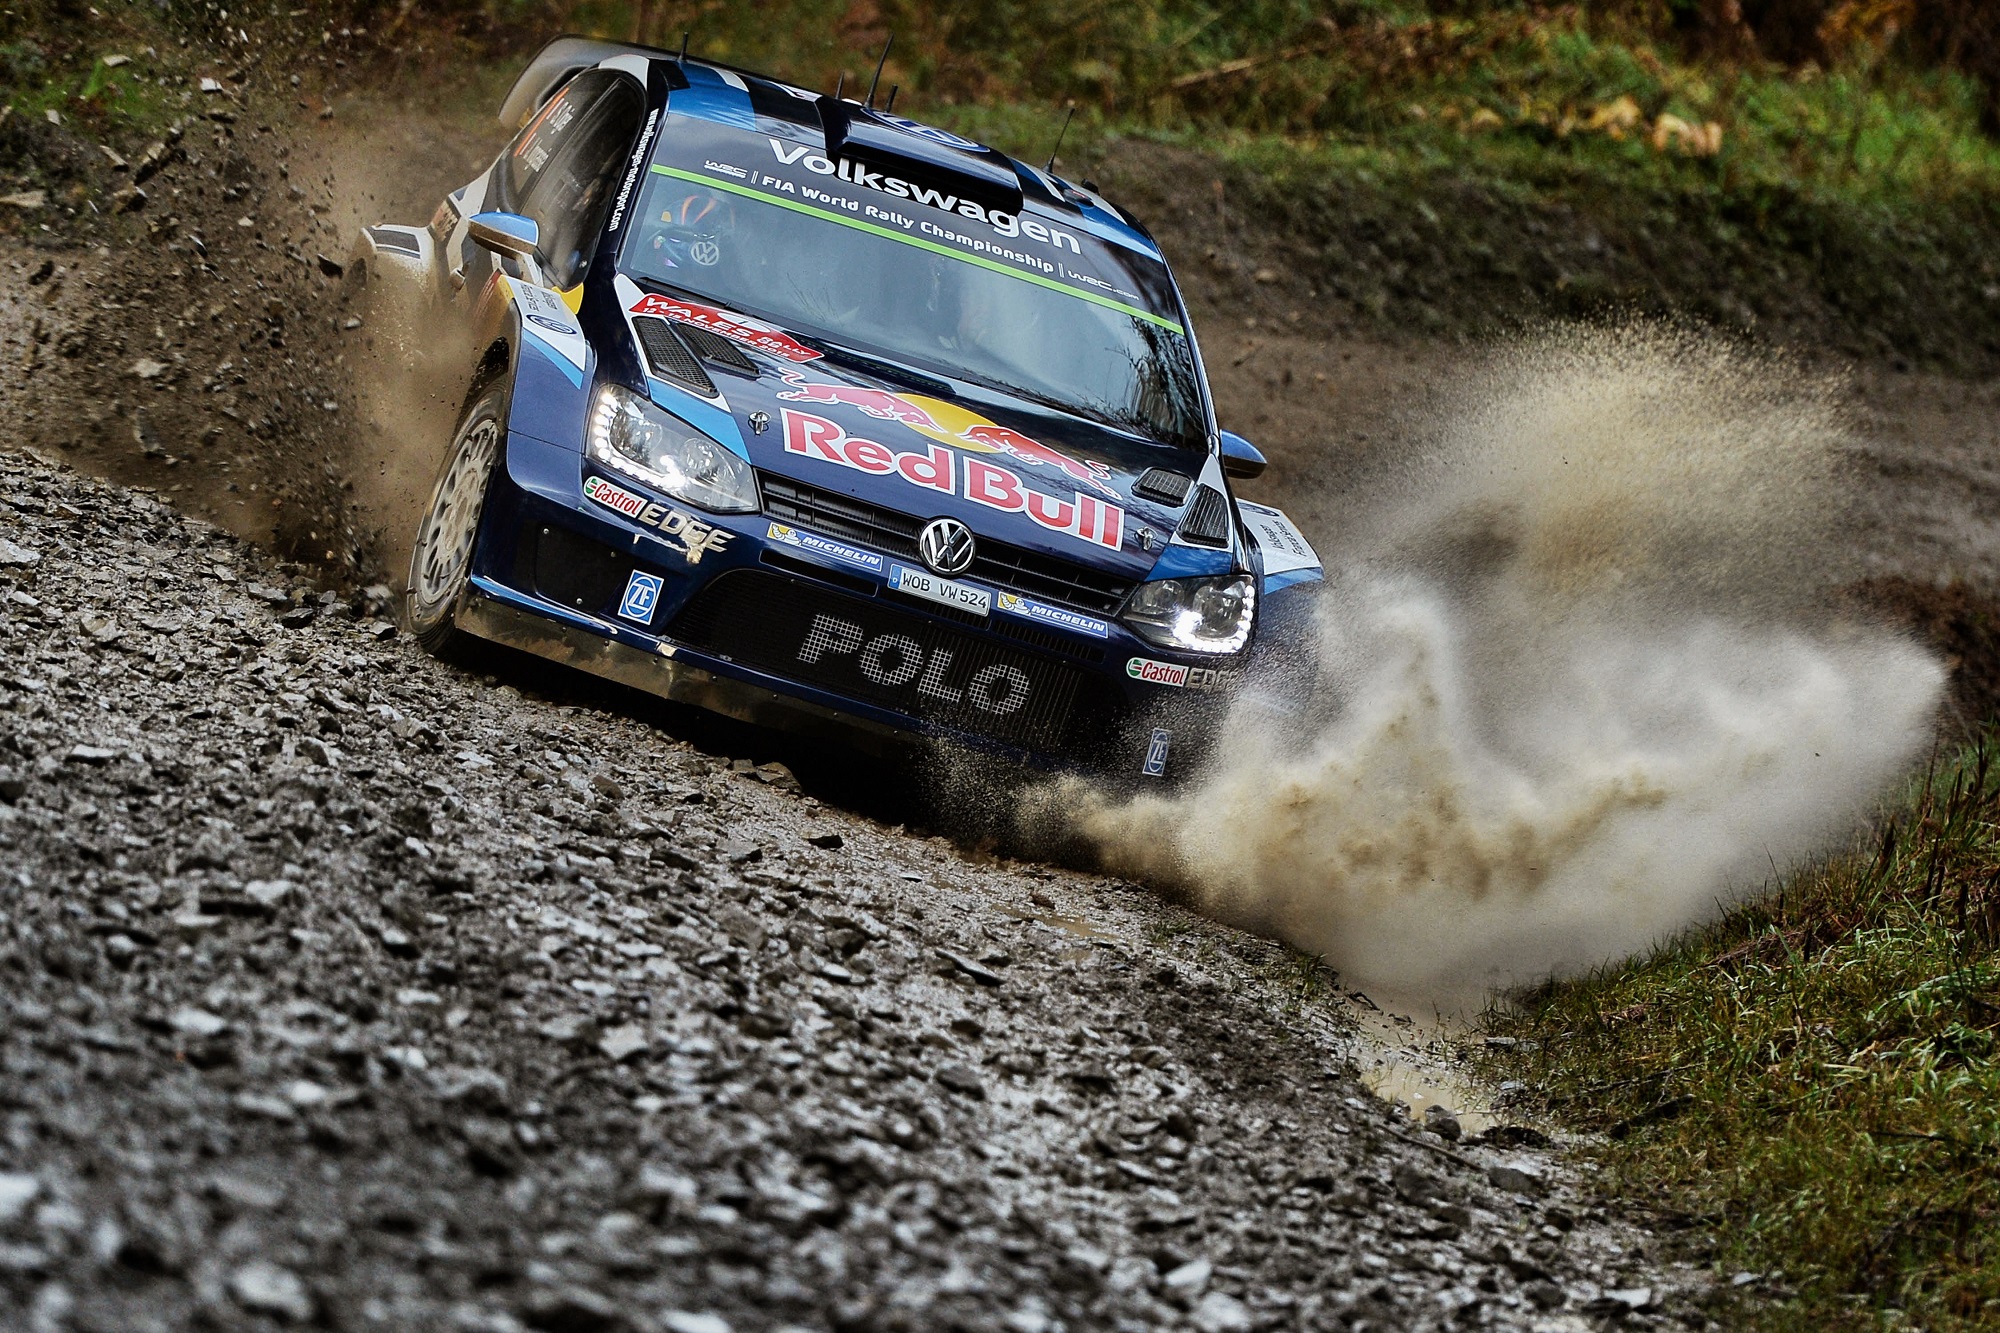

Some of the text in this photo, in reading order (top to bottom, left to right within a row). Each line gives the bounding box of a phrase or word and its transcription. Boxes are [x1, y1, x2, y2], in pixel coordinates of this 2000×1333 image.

[768, 138, 1082, 254] Volkswagen
[762, 174, 795, 194] FIA
[801, 185, 859, 212] World
[865, 205, 915, 230] Rally
[920, 221, 1055, 274] Championship
[646, 297, 755, 337] WALES
[684, 318, 759, 345] NOVEMBER
[780, 407, 1125, 552] Red Bull
[594, 483, 738, 553] Castrol EDGE
[801, 535, 881, 566] MICHELIN
[902, 572, 931, 592] WOB
[1030, 605, 1106, 632] MICHELIN
[797, 612, 1031, 716] POLO
[1141, 661, 1186, 685] Castrol
